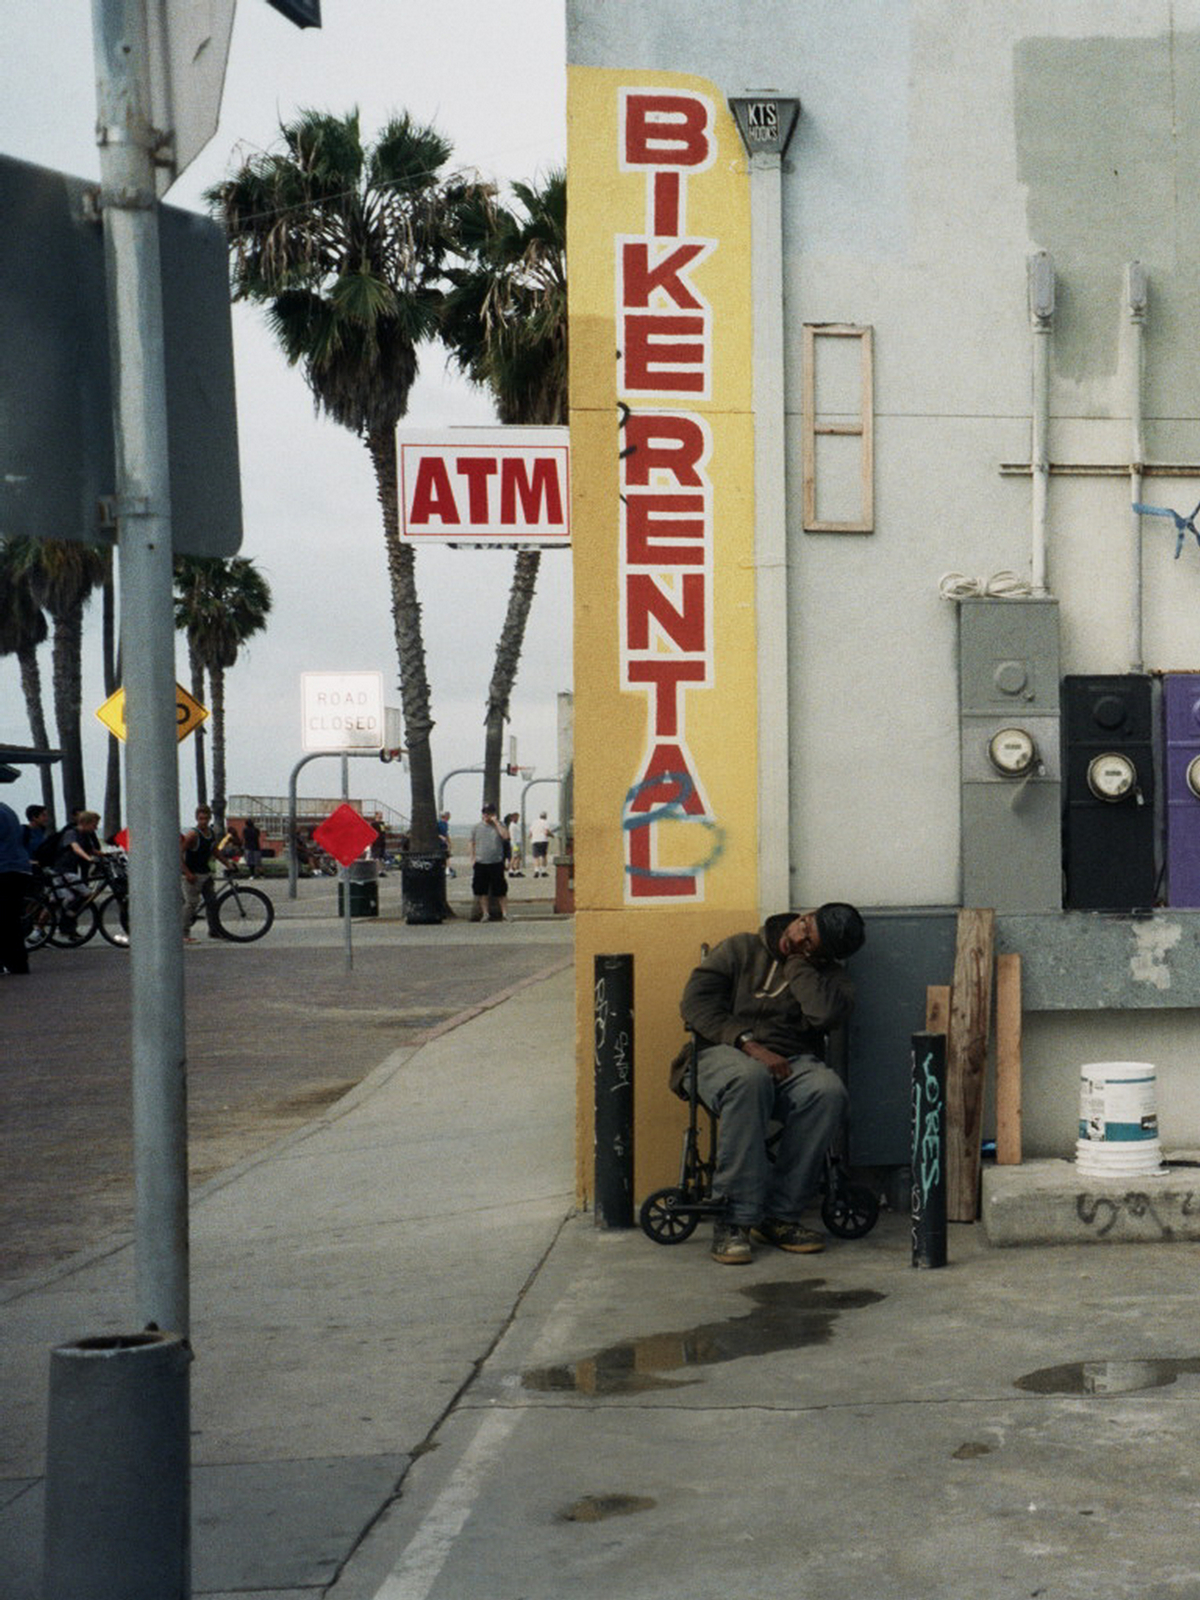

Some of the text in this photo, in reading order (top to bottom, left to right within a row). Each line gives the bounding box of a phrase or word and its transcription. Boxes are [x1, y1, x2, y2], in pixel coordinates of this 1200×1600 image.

[747, 103, 777, 125] KTS
[619, 91, 713, 396] BIKE
[409, 456, 564, 525] ATM
[620, 410, 712, 901] RENTAL
[317, 692, 367, 706] ROAD
[309, 715, 377, 731] CLOSED
